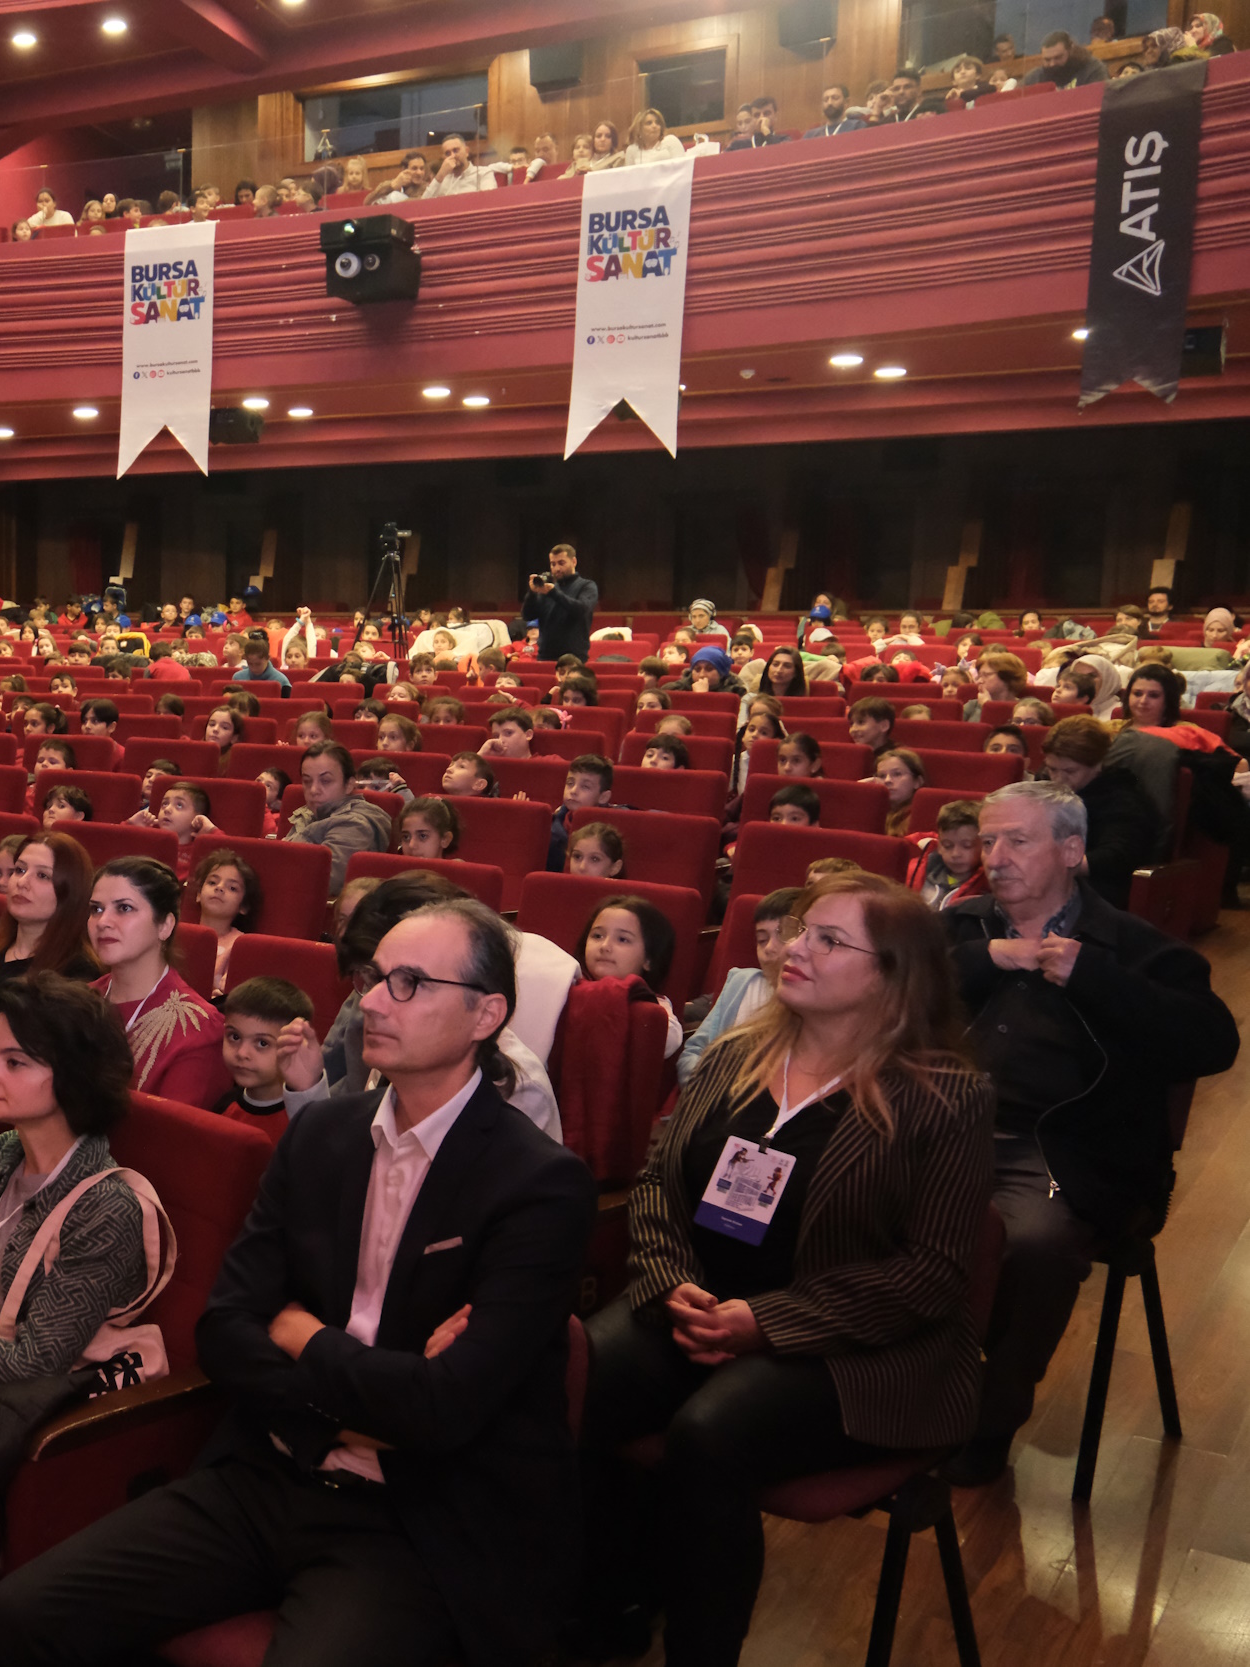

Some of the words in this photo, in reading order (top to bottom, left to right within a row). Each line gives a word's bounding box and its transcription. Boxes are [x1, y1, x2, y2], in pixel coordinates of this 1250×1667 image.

[1119, 130, 1170, 242] ATIŞ
[588, 205, 670, 234] BURSA
[587, 227, 672, 256] KÜLTÜR
[131, 259, 199, 284] BURSA
[585, 248, 678, 283] SANAT
[130, 278, 201, 303] KÜLTÜR
[129, 296, 206, 326] SANAT
